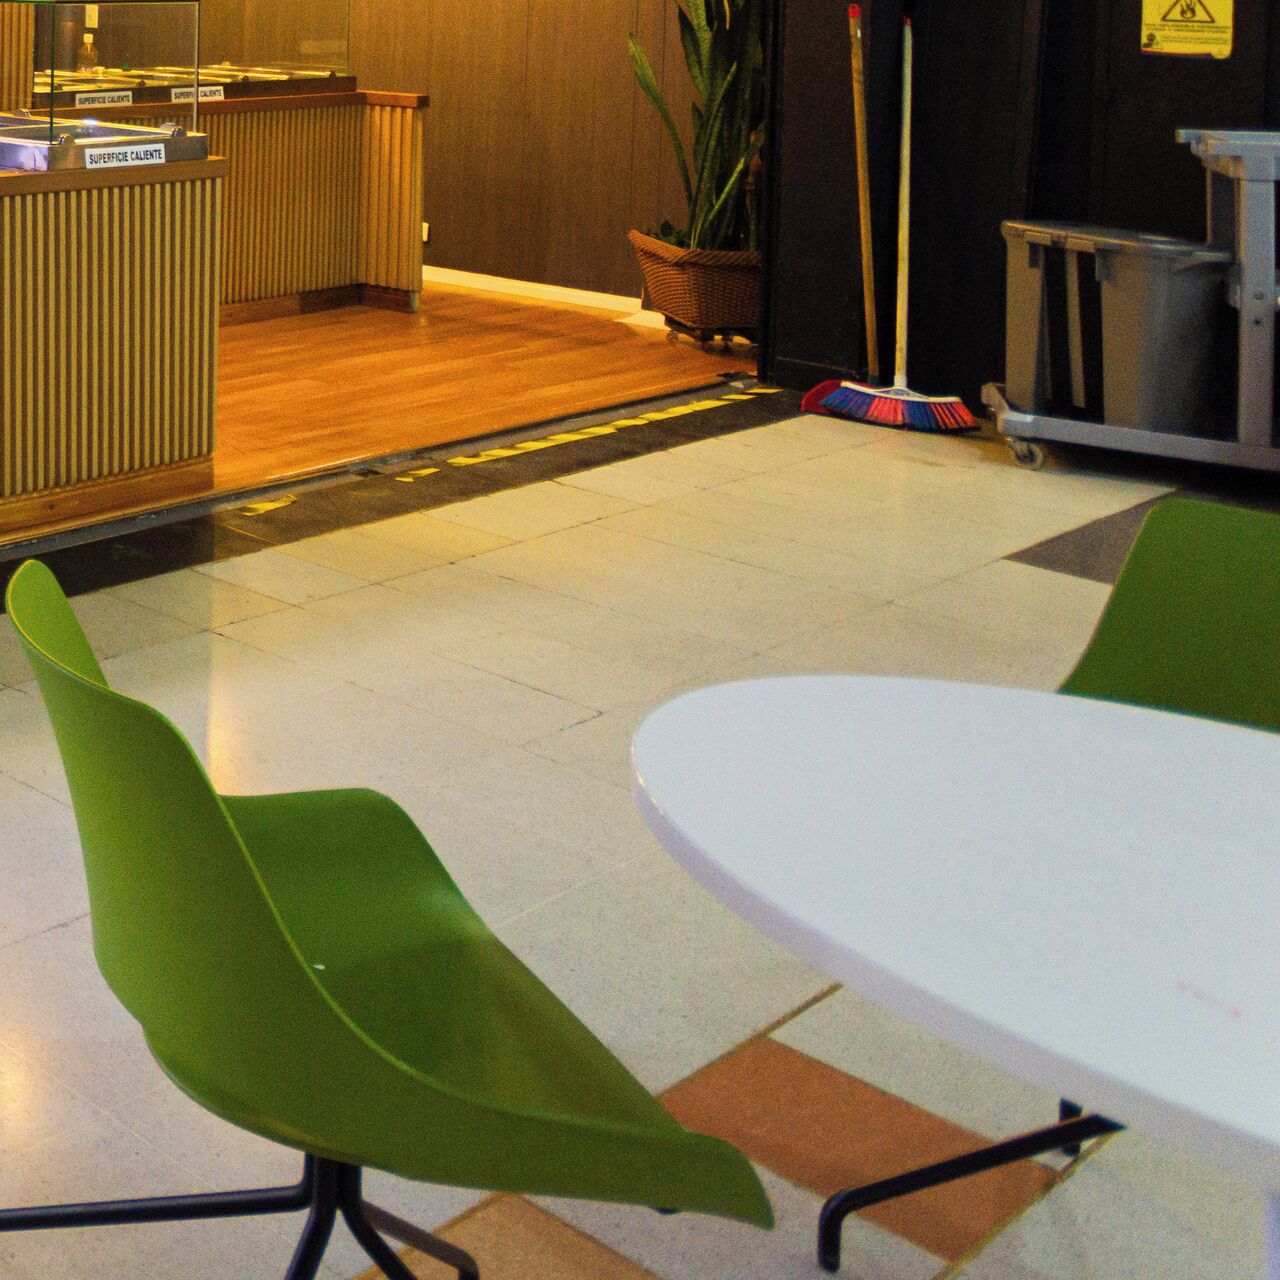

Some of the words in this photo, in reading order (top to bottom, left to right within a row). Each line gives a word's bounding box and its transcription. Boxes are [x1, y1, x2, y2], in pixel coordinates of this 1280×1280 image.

[200, 89, 222, 98] CALIENTE
[78, 96, 107, 106] SUPERFICIE
[107, 94, 130, 104] CALIENTE
[89, 151, 129, 165] SUPERFICIE
[130, 148, 162, 163] CALIENTE
